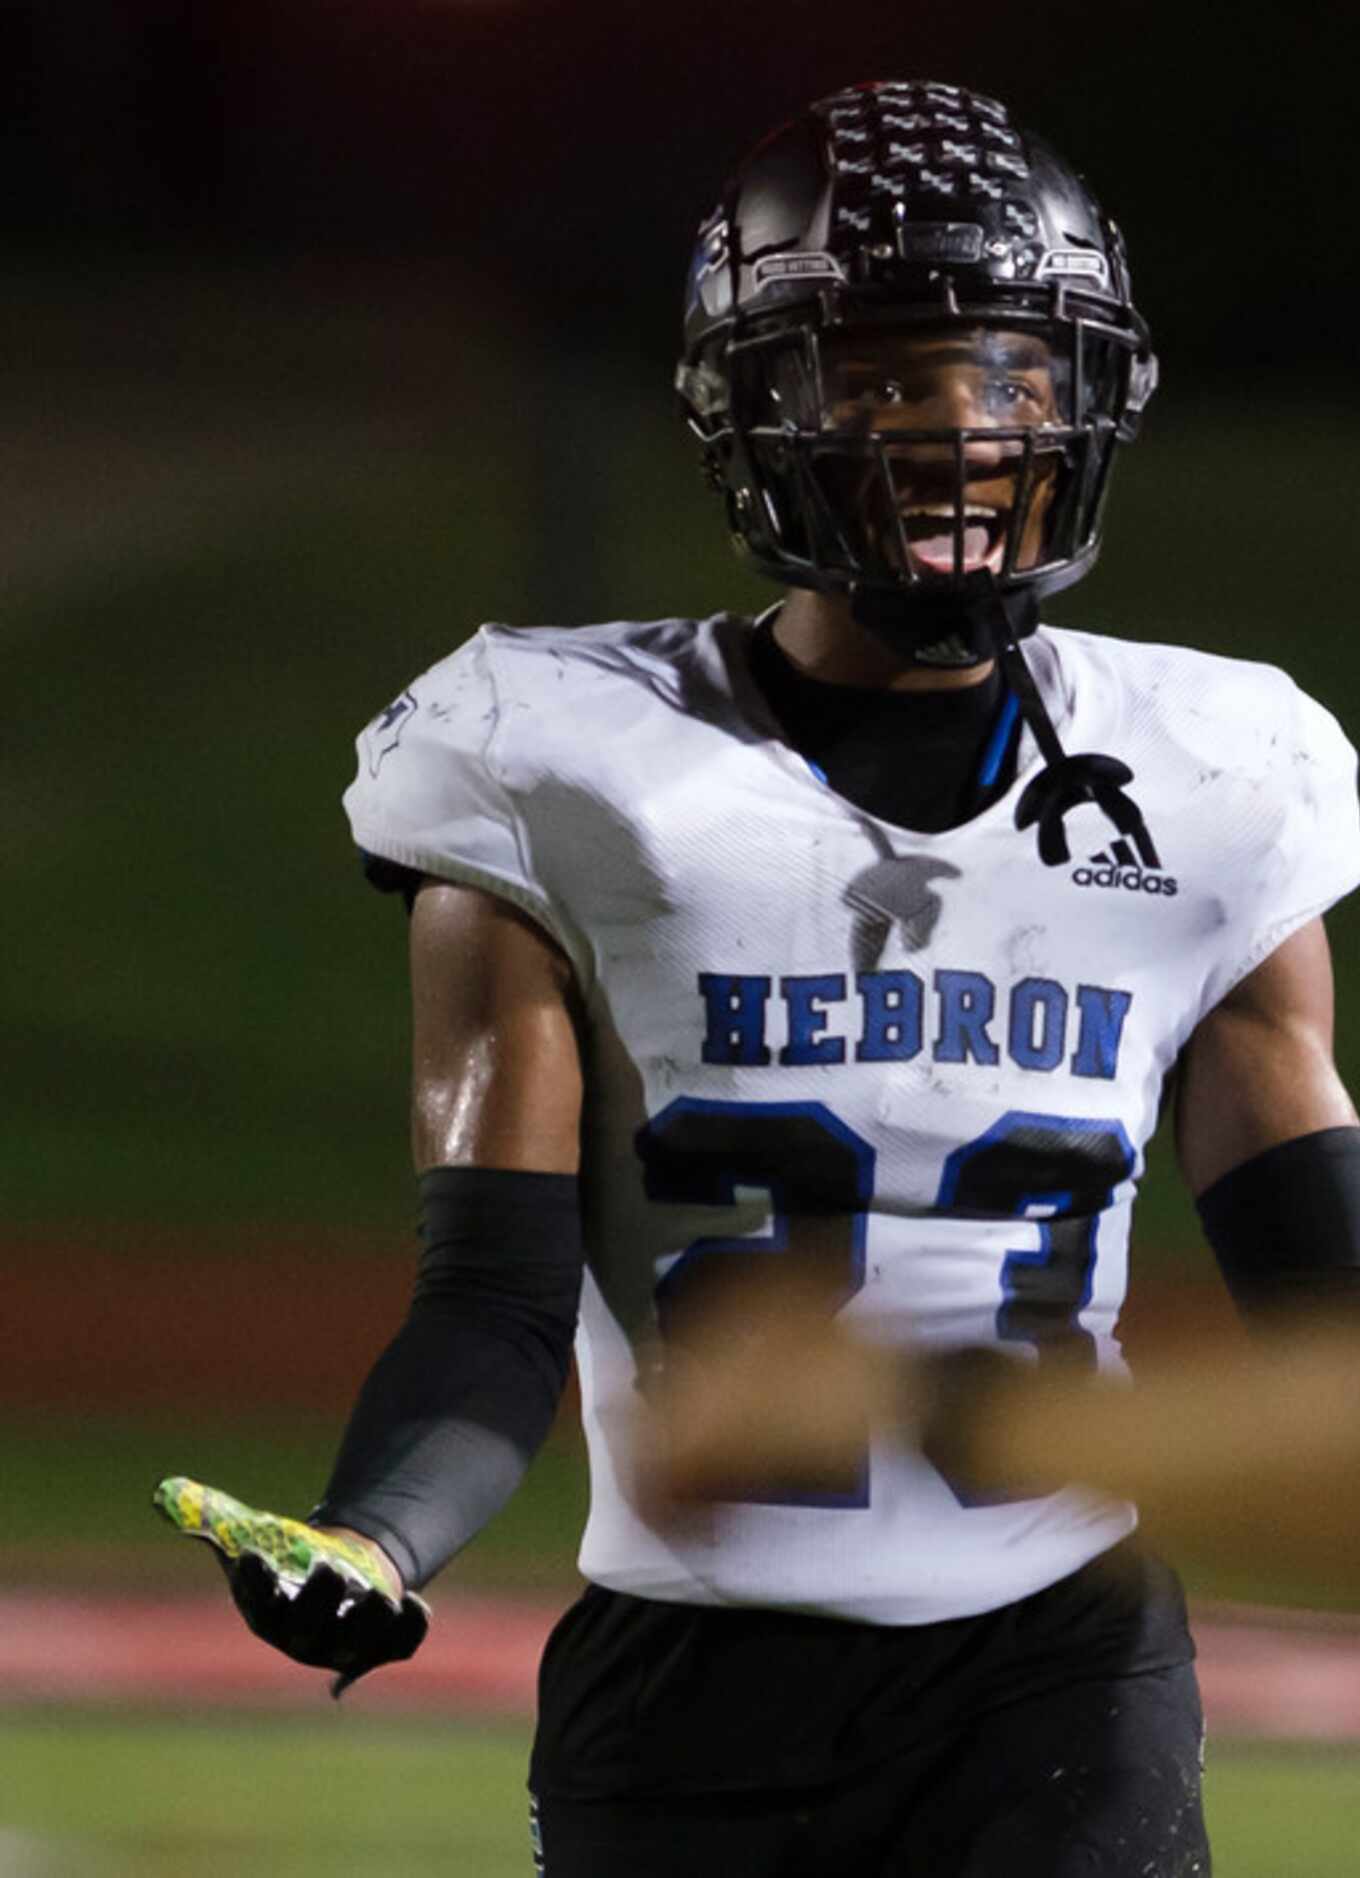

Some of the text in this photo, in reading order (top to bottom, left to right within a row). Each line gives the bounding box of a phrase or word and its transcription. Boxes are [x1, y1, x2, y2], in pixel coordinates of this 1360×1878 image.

[1071, 864, 1178, 896] adidas
[698, 968, 1133, 1080] HEBRON
[634, 1095, 1138, 1510] 23
